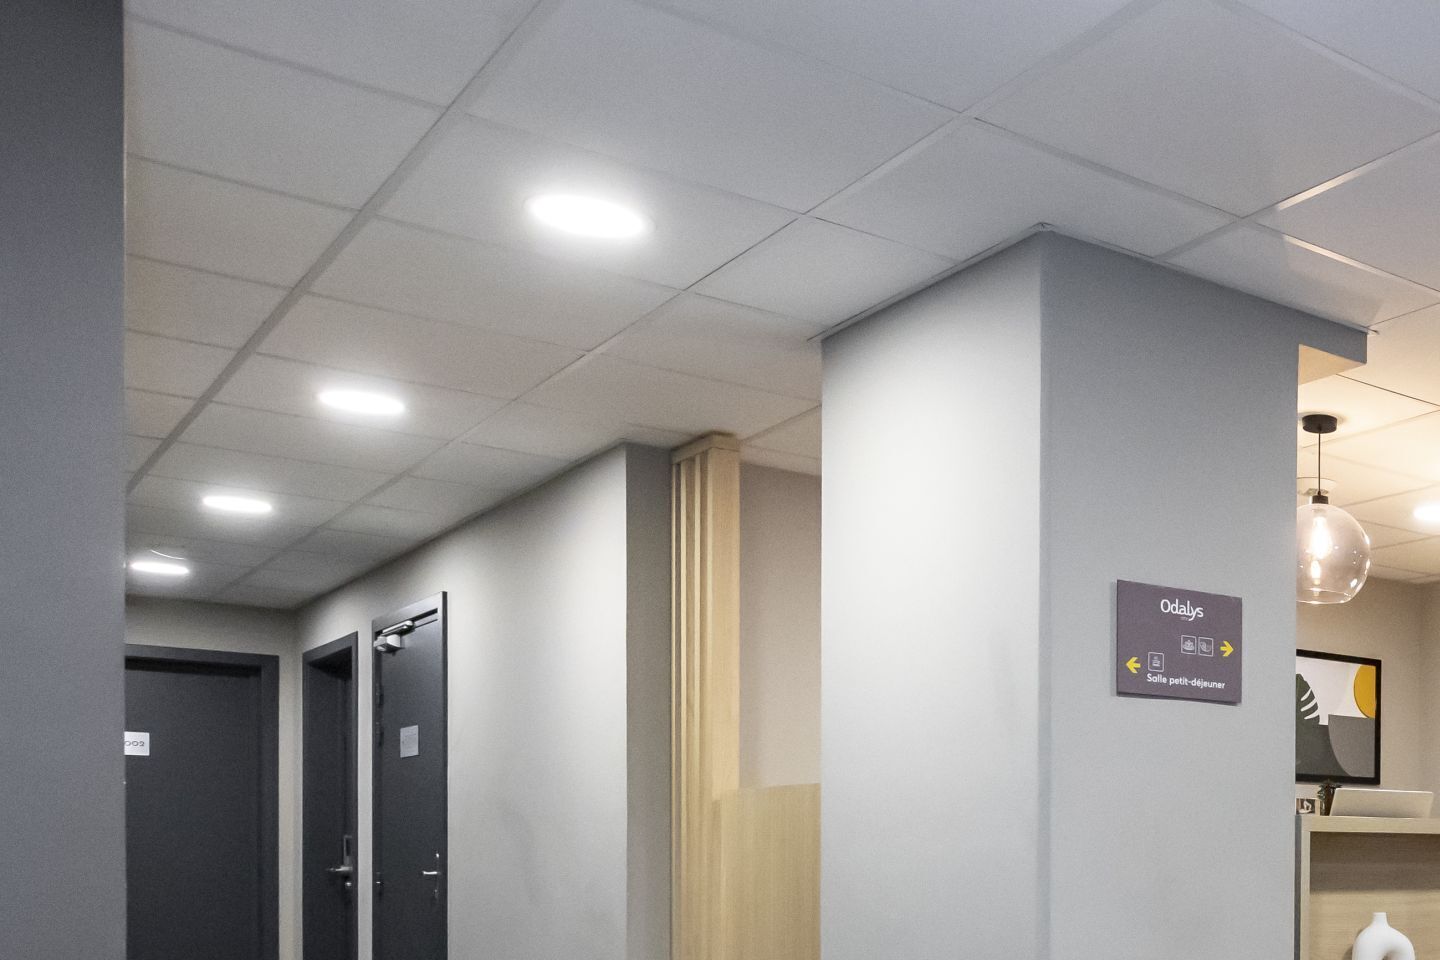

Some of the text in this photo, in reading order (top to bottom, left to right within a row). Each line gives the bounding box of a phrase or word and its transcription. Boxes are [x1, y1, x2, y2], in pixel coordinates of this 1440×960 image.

[1160, 598, 1204, 621] Odalys
[1146, 673, 1226, 689] Salle petit-déjeuner
